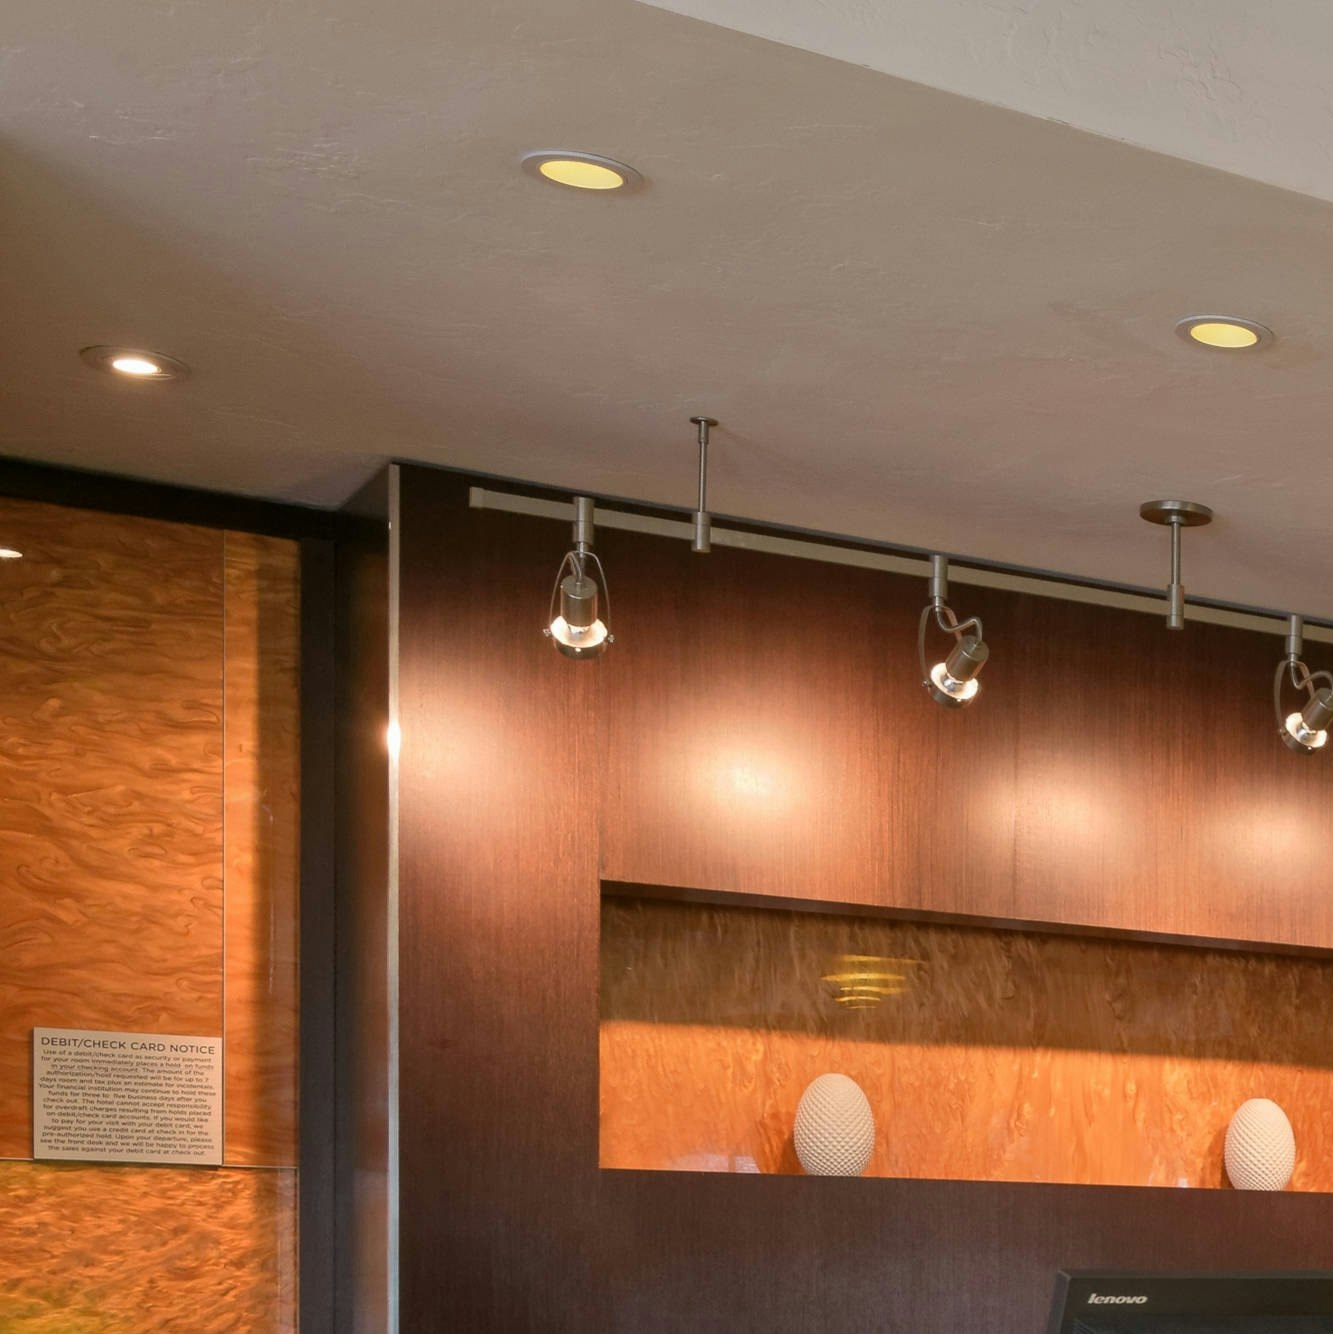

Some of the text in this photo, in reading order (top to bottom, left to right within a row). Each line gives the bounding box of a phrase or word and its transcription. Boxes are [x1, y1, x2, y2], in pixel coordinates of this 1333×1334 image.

[41, 1037, 215, 1054] DEBIT/CHECK CARD NOTICE
[1087, 1293, 1148, 1305] lenovo
